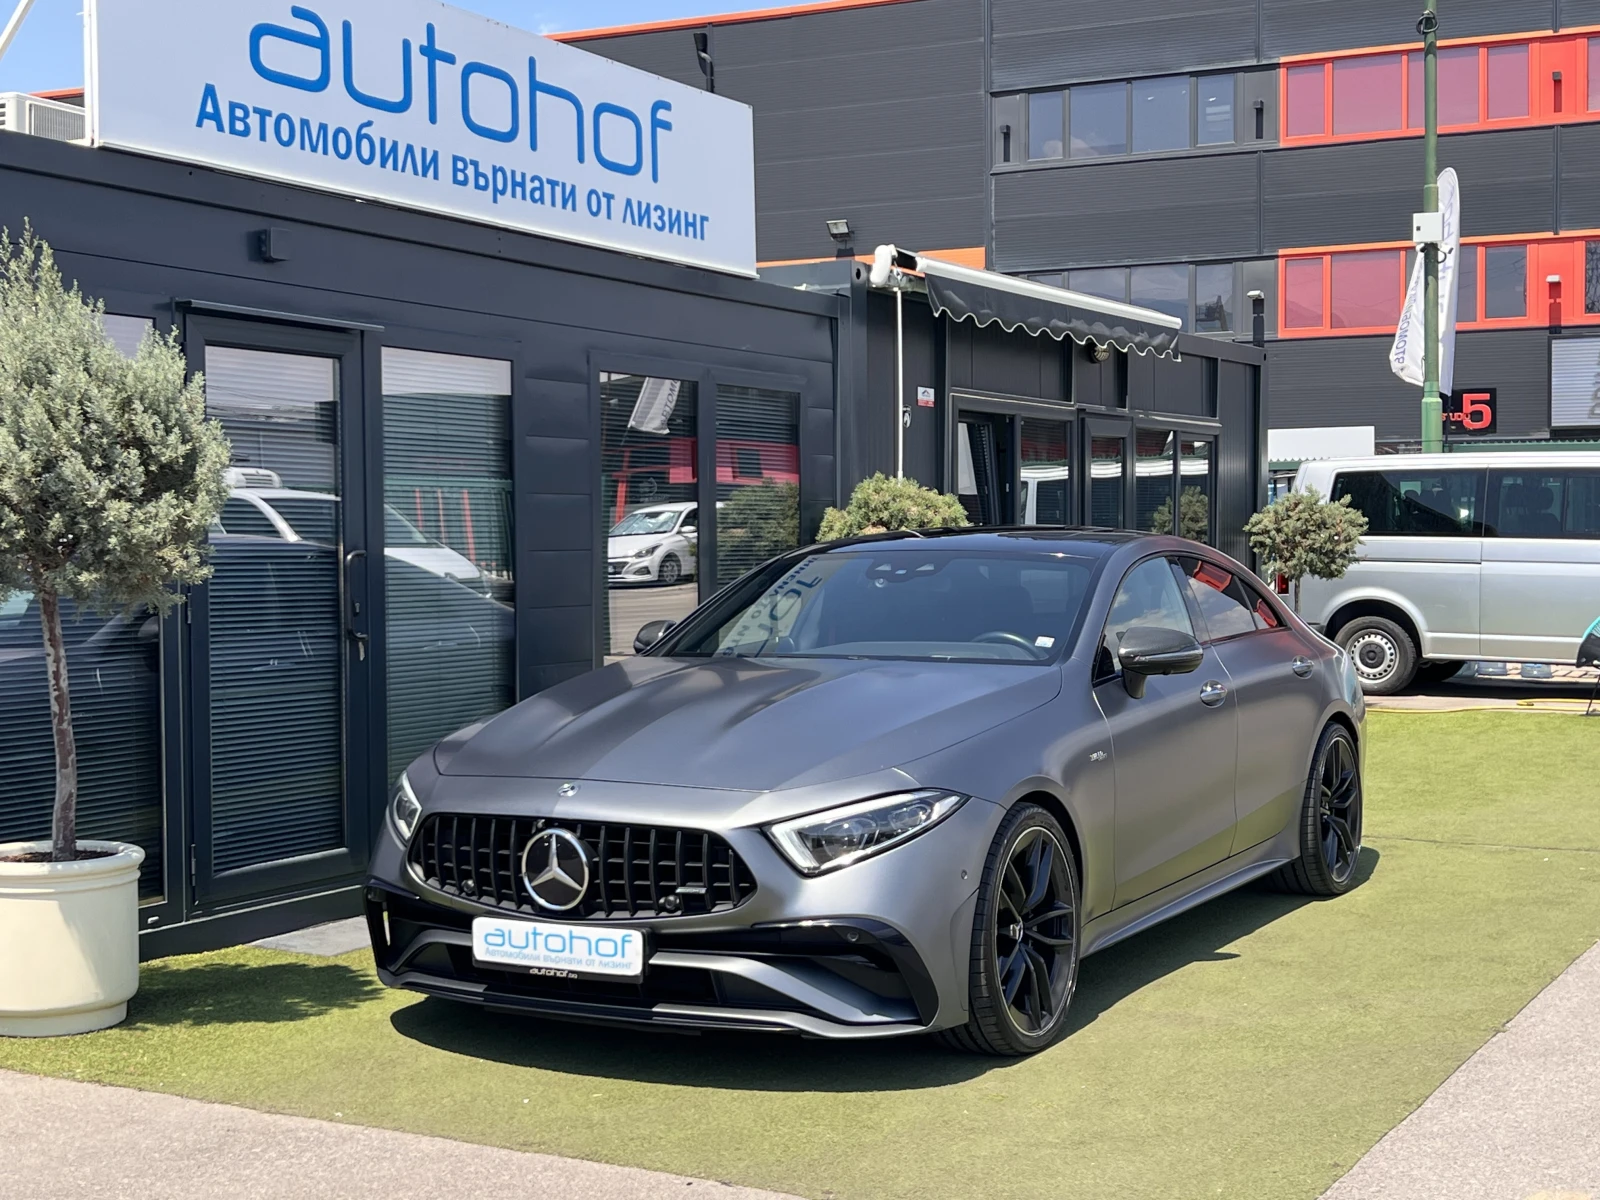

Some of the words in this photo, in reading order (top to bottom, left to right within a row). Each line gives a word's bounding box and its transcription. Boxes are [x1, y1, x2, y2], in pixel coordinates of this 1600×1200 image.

[250, 5, 673, 183] autohof
[196, 83, 440, 181] Автомобили
[452, 154, 577, 204] върнати
[587, 189, 615, 220] от
[622, 198, 709, 241] лизинг
[1462, 392, 1492, 430] 5
[484, 927, 633, 959] autohof
[485, 947, 541, 961] Автомобили
[585, 959, 595, 967] от
